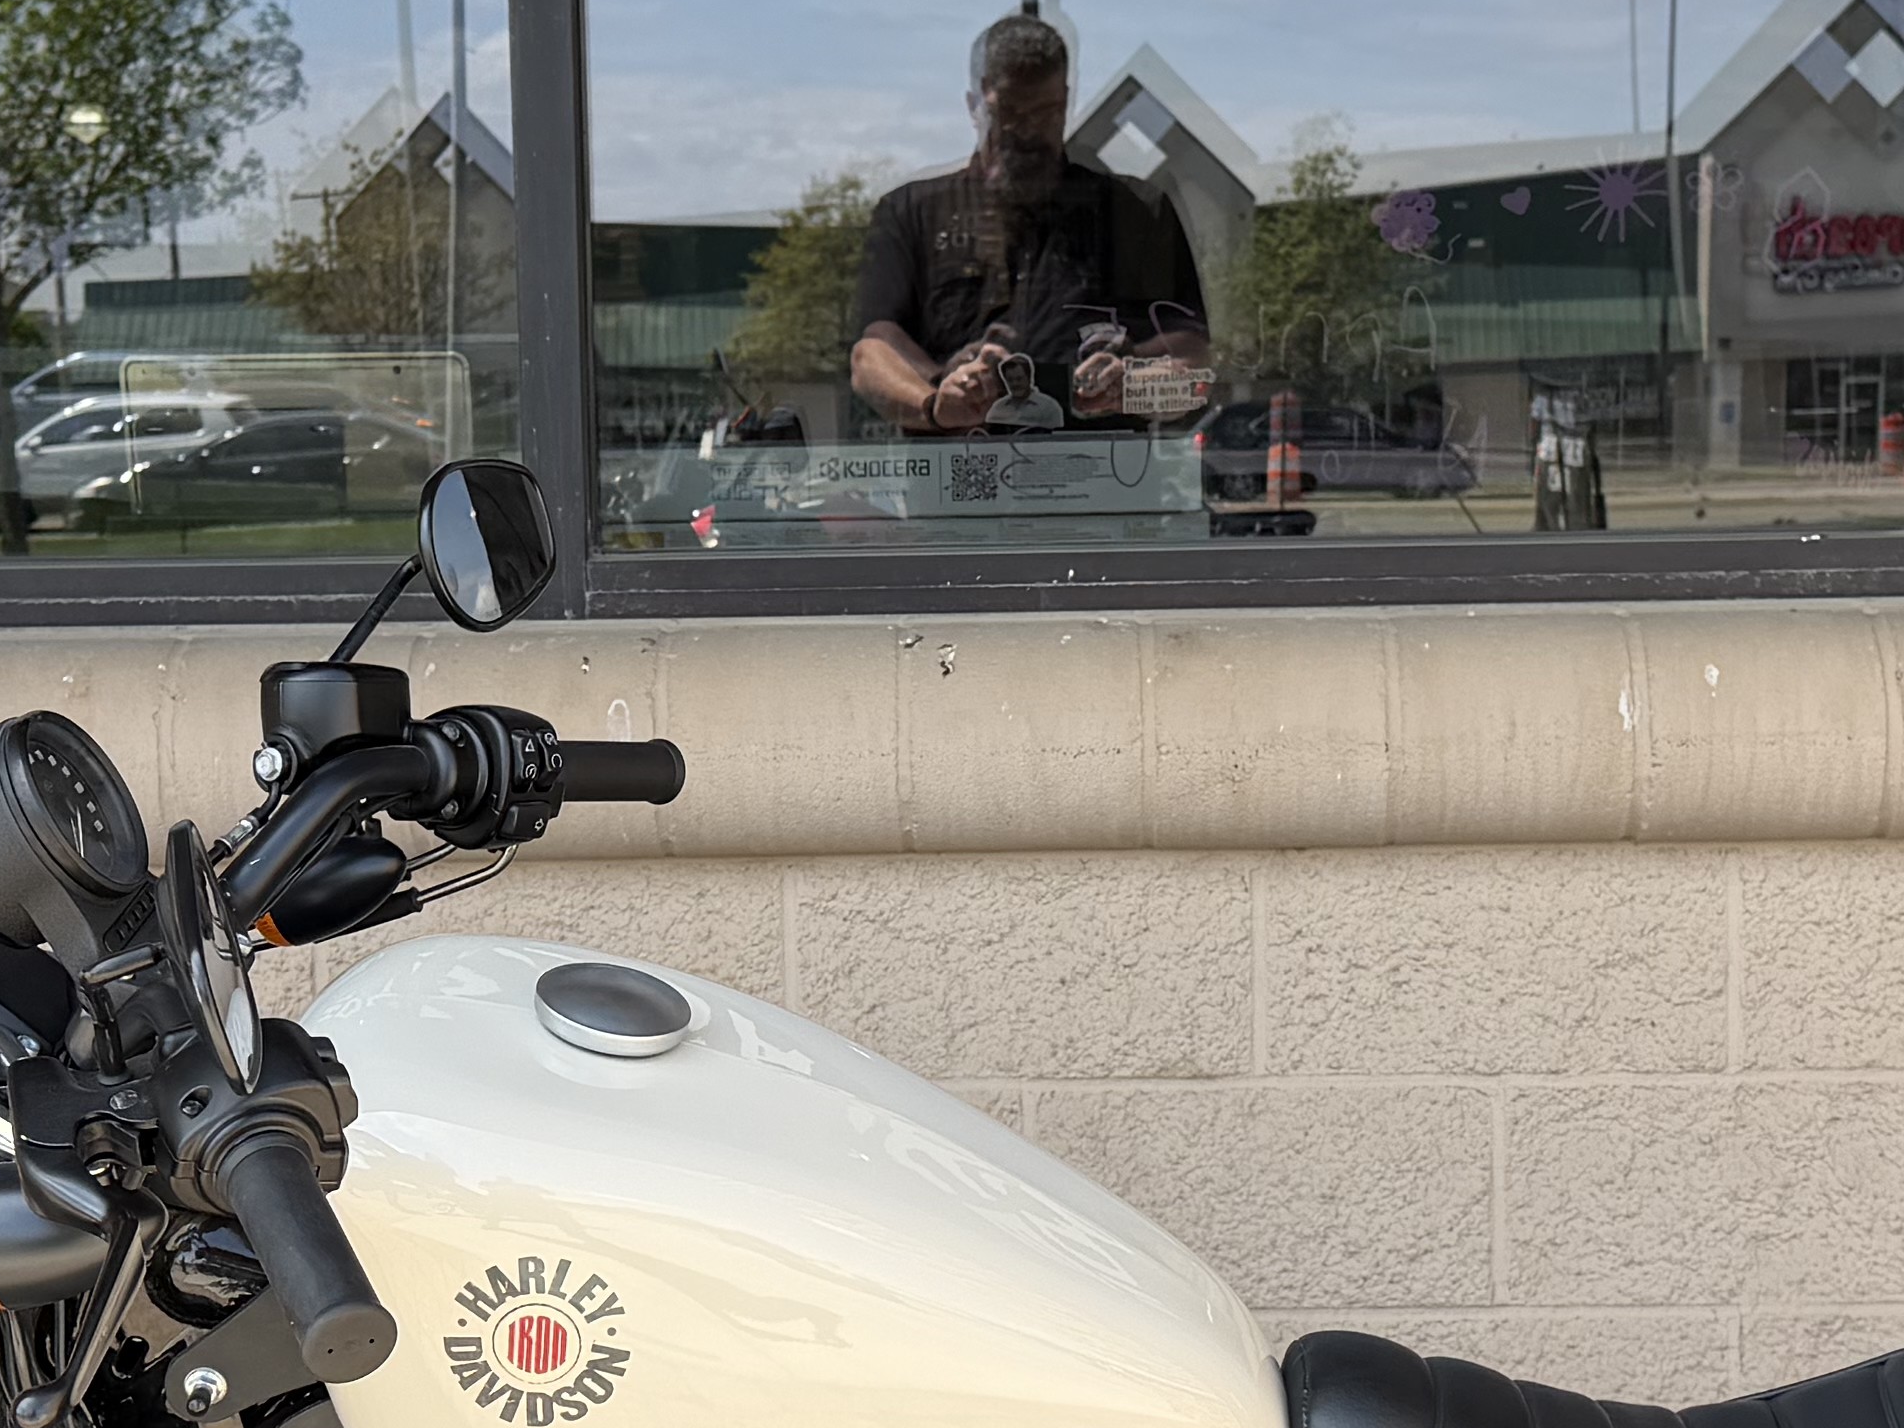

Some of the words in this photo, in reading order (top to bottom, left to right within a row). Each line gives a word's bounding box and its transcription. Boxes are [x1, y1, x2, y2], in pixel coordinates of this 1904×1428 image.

[843, 458, 931, 478] KYOCERA
[453, 1255, 626, 1325] HARLEY
[506, 1315, 568, 1375] IRON
[442, 1336, 632, 1428] DAVIDSON
